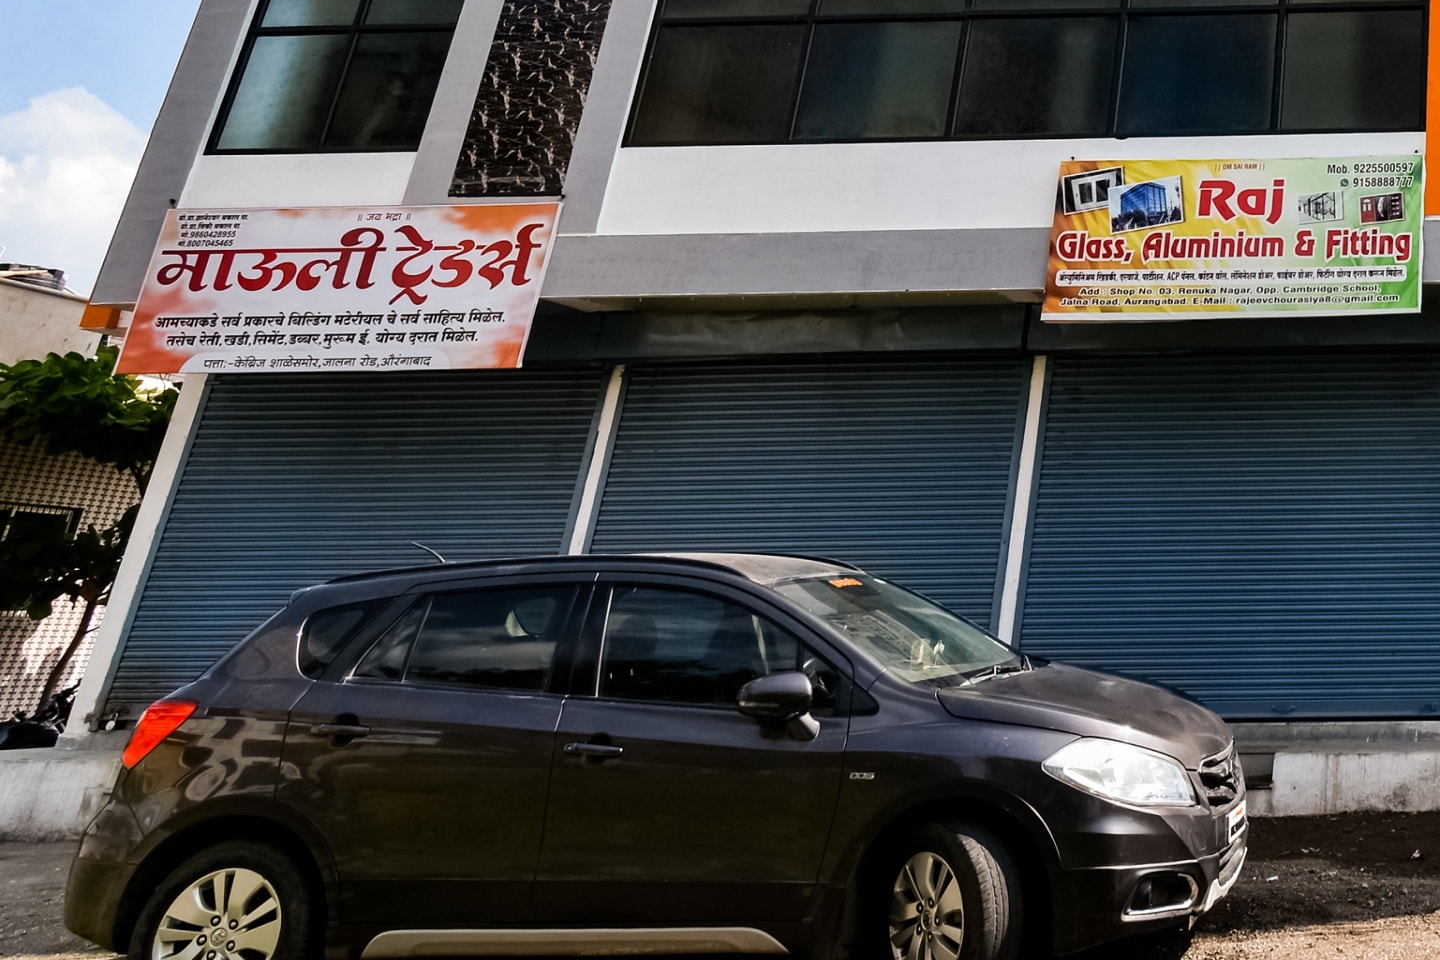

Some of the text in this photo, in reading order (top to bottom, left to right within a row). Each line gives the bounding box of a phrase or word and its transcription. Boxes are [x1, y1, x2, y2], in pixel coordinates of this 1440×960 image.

[1327, 162, 1414, 174] Mob. 9225500597
[1352, 176, 1413, 187] 9158888777
[1197, 178, 1285, 225] Raj
[366, 213, 382, 221] जय
[1059, 229, 1412, 262] Glass, Aluminium & Fitting
[156, 223, 544, 306] माऊली ट्रेडर्स
[1167, 271, 1180, 281] ACP
[1080, 287, 1101, 296] Add
[1109, 287, 1136, 298] Shop
[1178, 286, 1217, 295] Renuka
[1220, 286, 1253, 297] Nagar,
[1255, 286, 1279, 296] Opp.
[1282, 284, 1340, 295] Cambridge
[1342, 283, 1381, 294] School,
[1060, 298, 1089, 307] Jalna
[1091, 298, 1121, 307] Road,
[1192, 297, 1227, 306] E-Mail
[221, 311, 243, 328] सर्व
[243, 311, 285, 328] प्रकारचे
[386, 309, 398, 325] चे
[400, 308, 423, 325] सर्व
[423, 308, 466, 326] साहित्य
[166, 331, 198, 348] तसेच
[375, 328, 406, 344] योग्य
[409, 330, 439, 346] दरात
